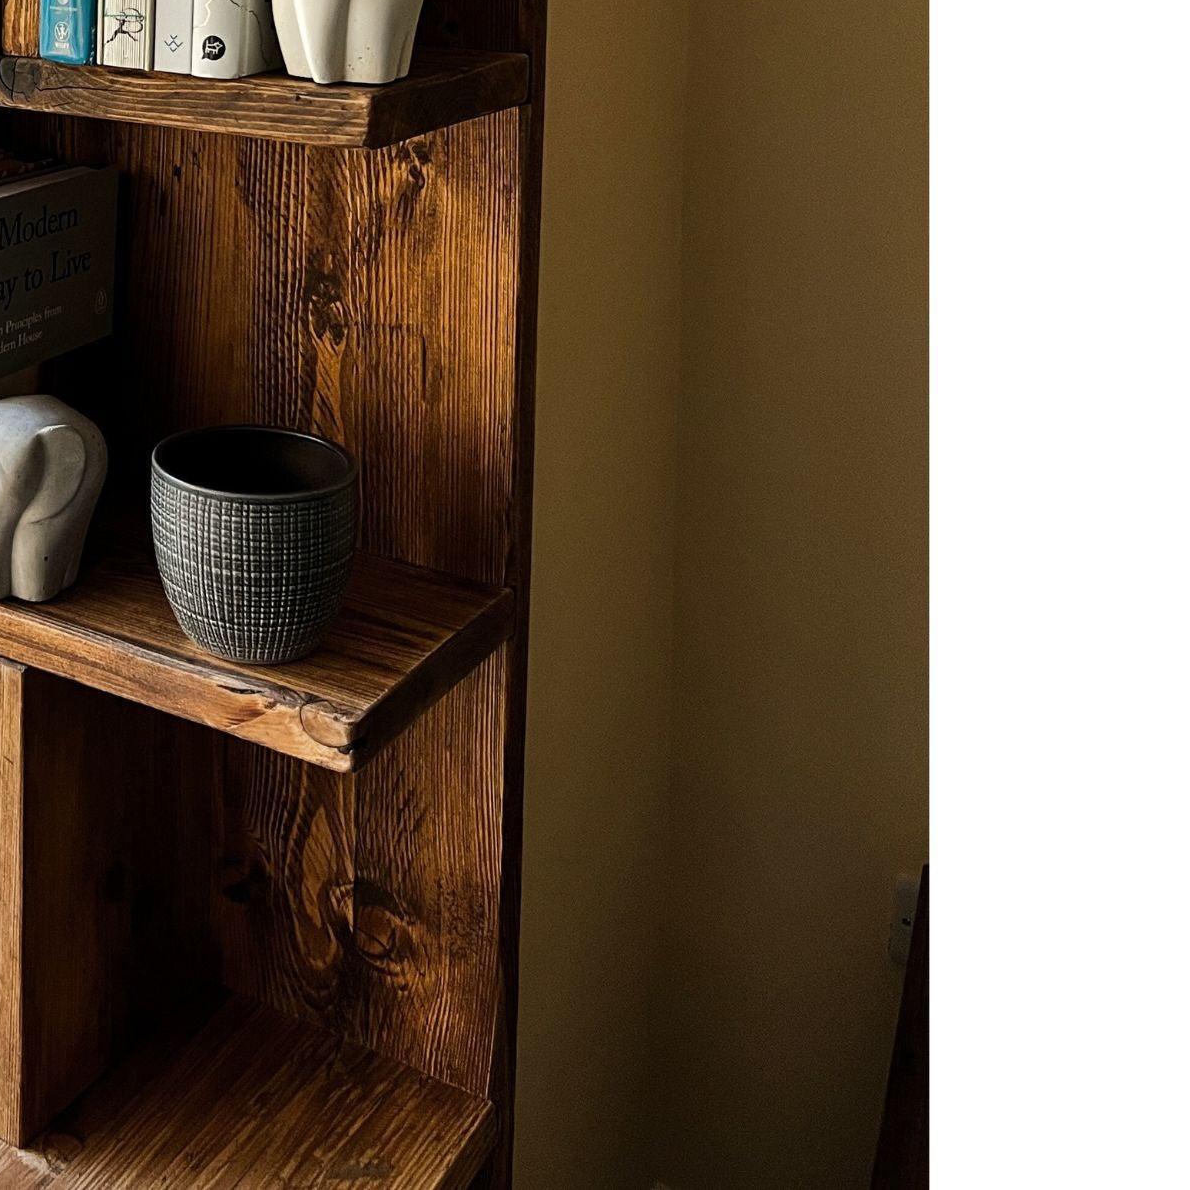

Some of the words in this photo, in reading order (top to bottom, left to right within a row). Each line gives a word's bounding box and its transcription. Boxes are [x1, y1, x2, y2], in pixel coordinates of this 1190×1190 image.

[24, 267, 44, 292] to
[50, 250, 92, 283] Live
[5, 309, 43, 333] Principles
[44, 304, 63, 320] from
[18, 330, 43, 350] House
